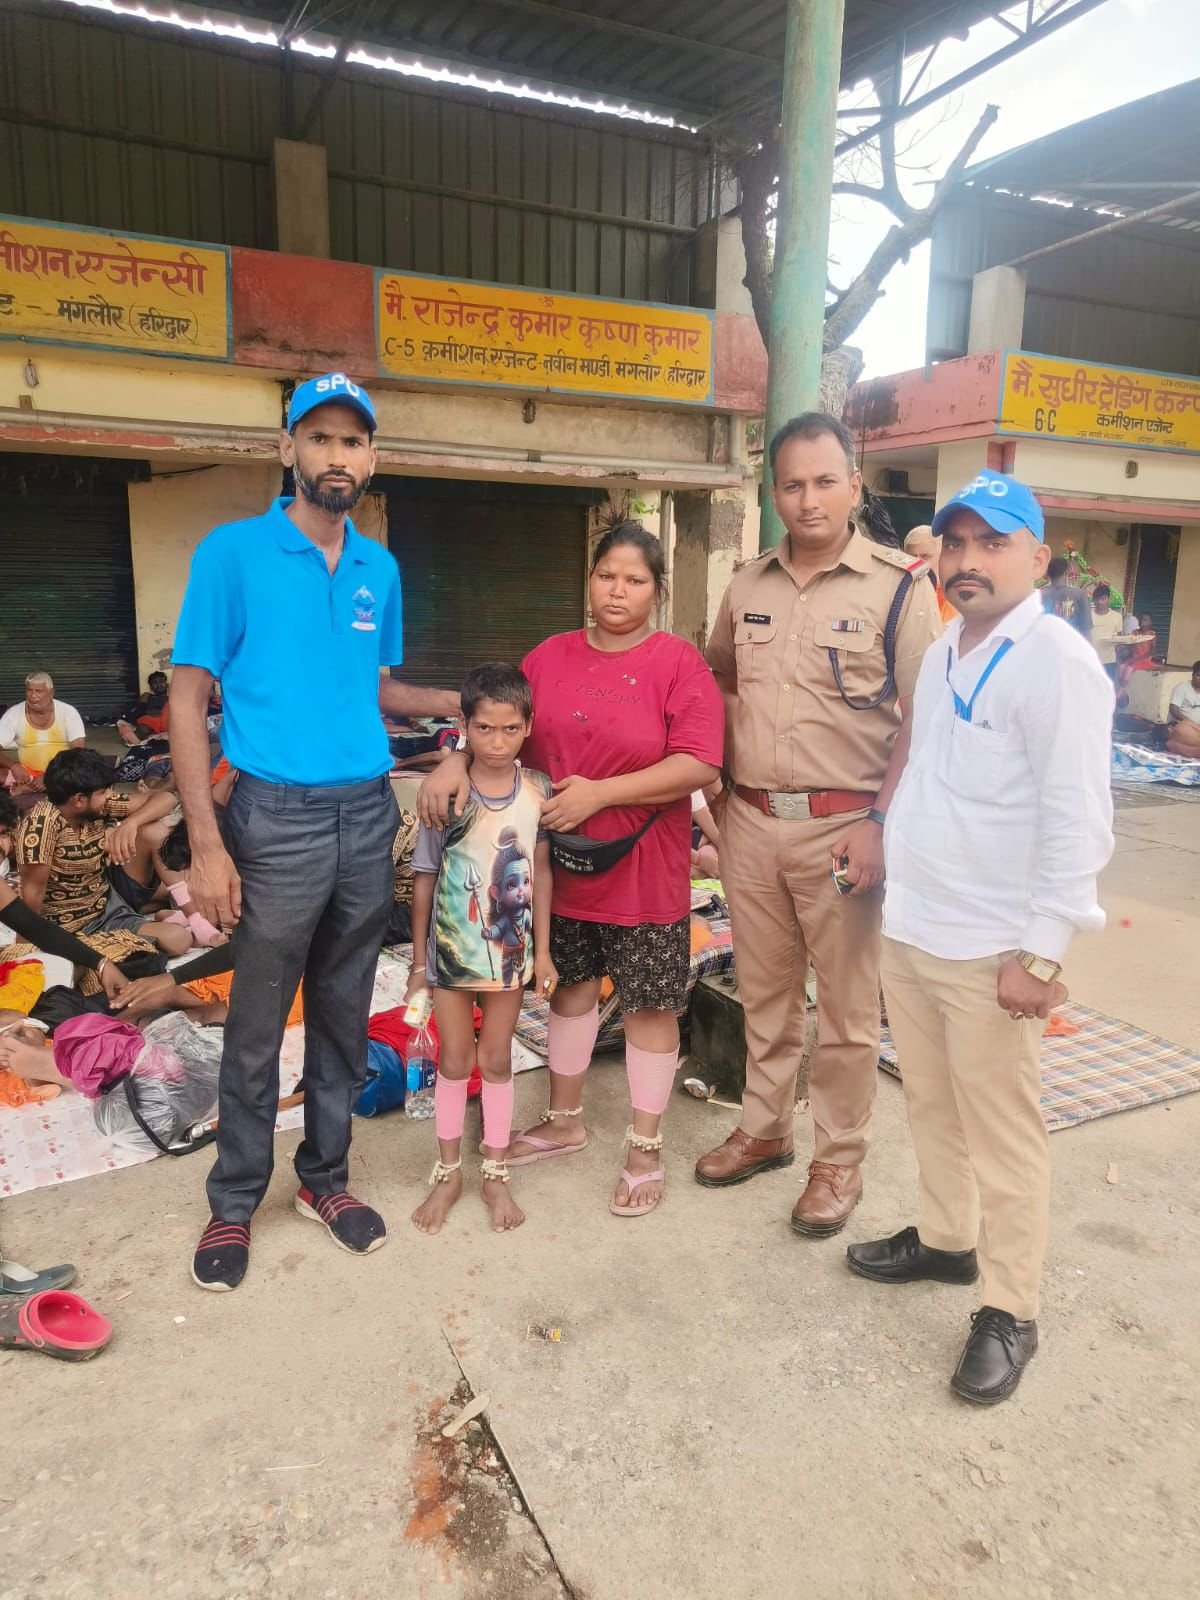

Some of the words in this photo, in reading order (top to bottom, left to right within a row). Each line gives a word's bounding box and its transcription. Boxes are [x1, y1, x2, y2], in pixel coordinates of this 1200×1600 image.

[57, 294, 126, 331] मंगलौर
[411, 288, 504, 336] राजेन्द्र
[508, 308, 573, 342] कुमार
[577, 316, 640, 349] कृष्ण
[644, 325, 702, 355] कुमार
[385, 337, 415, 357] C-5
[615, 354, 662, 383] मंगलौर
[315, 373, 361, 398] SPO
[1039, 368, 1100, 409] सुधीर
[1096, 410, 1144, 433] कमीशन
[1145, 416, 1174, 434] एजेन्ट
